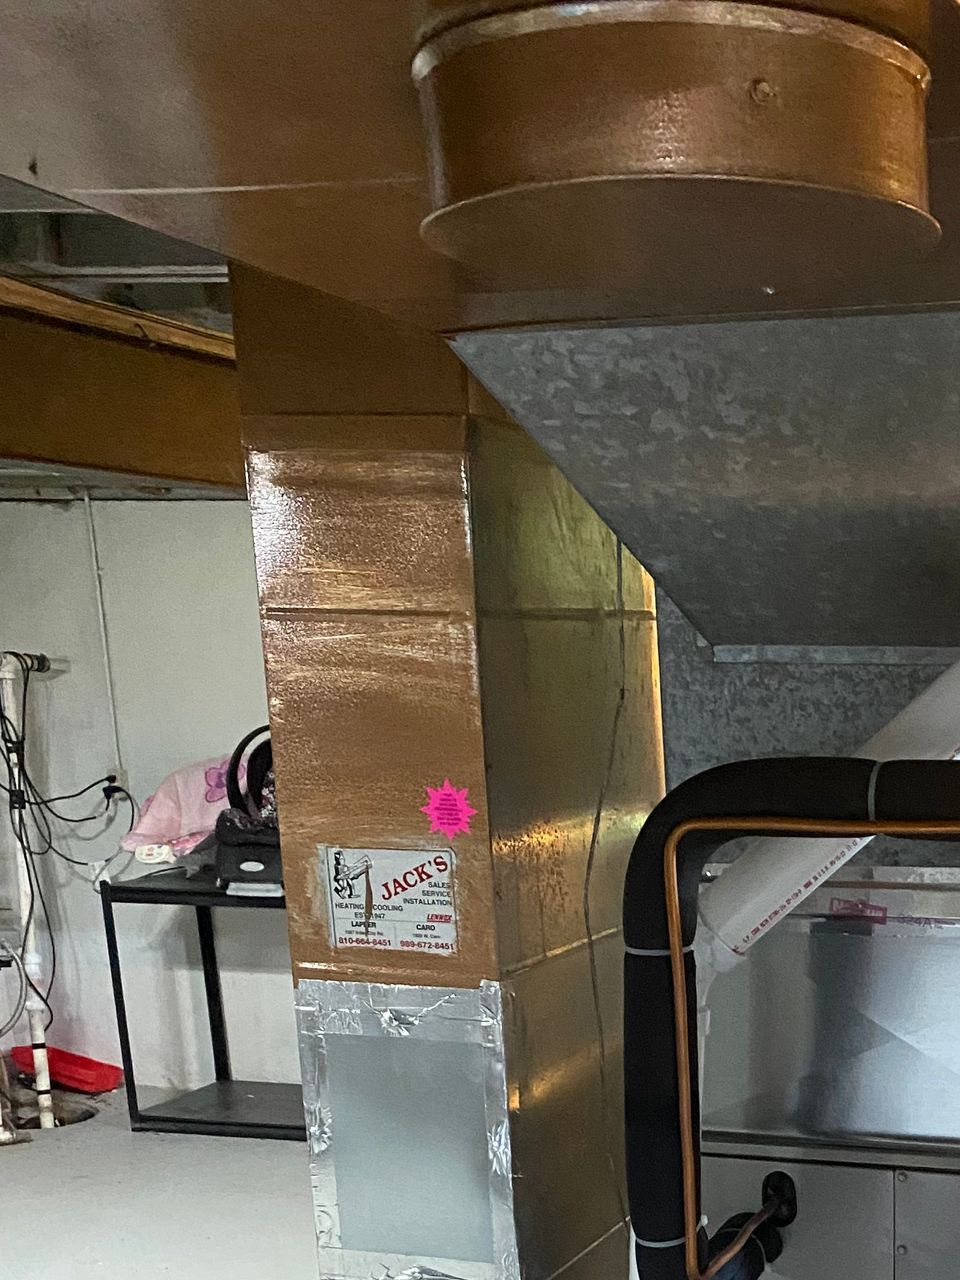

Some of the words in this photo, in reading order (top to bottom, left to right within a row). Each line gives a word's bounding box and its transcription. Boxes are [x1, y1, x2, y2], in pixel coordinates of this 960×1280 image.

[381, 856, 448, 900] JACK'S
[428, 881, 451, 889] SALES
[421, 890, 451, 898] SERVICE
[403, 898, 452, 906] INSTALLATION
[335, 902, 365, 910] HEATING
[372, 904, 404, 912] COOLING
[400, 940, 454, 950] 989-672-8451
